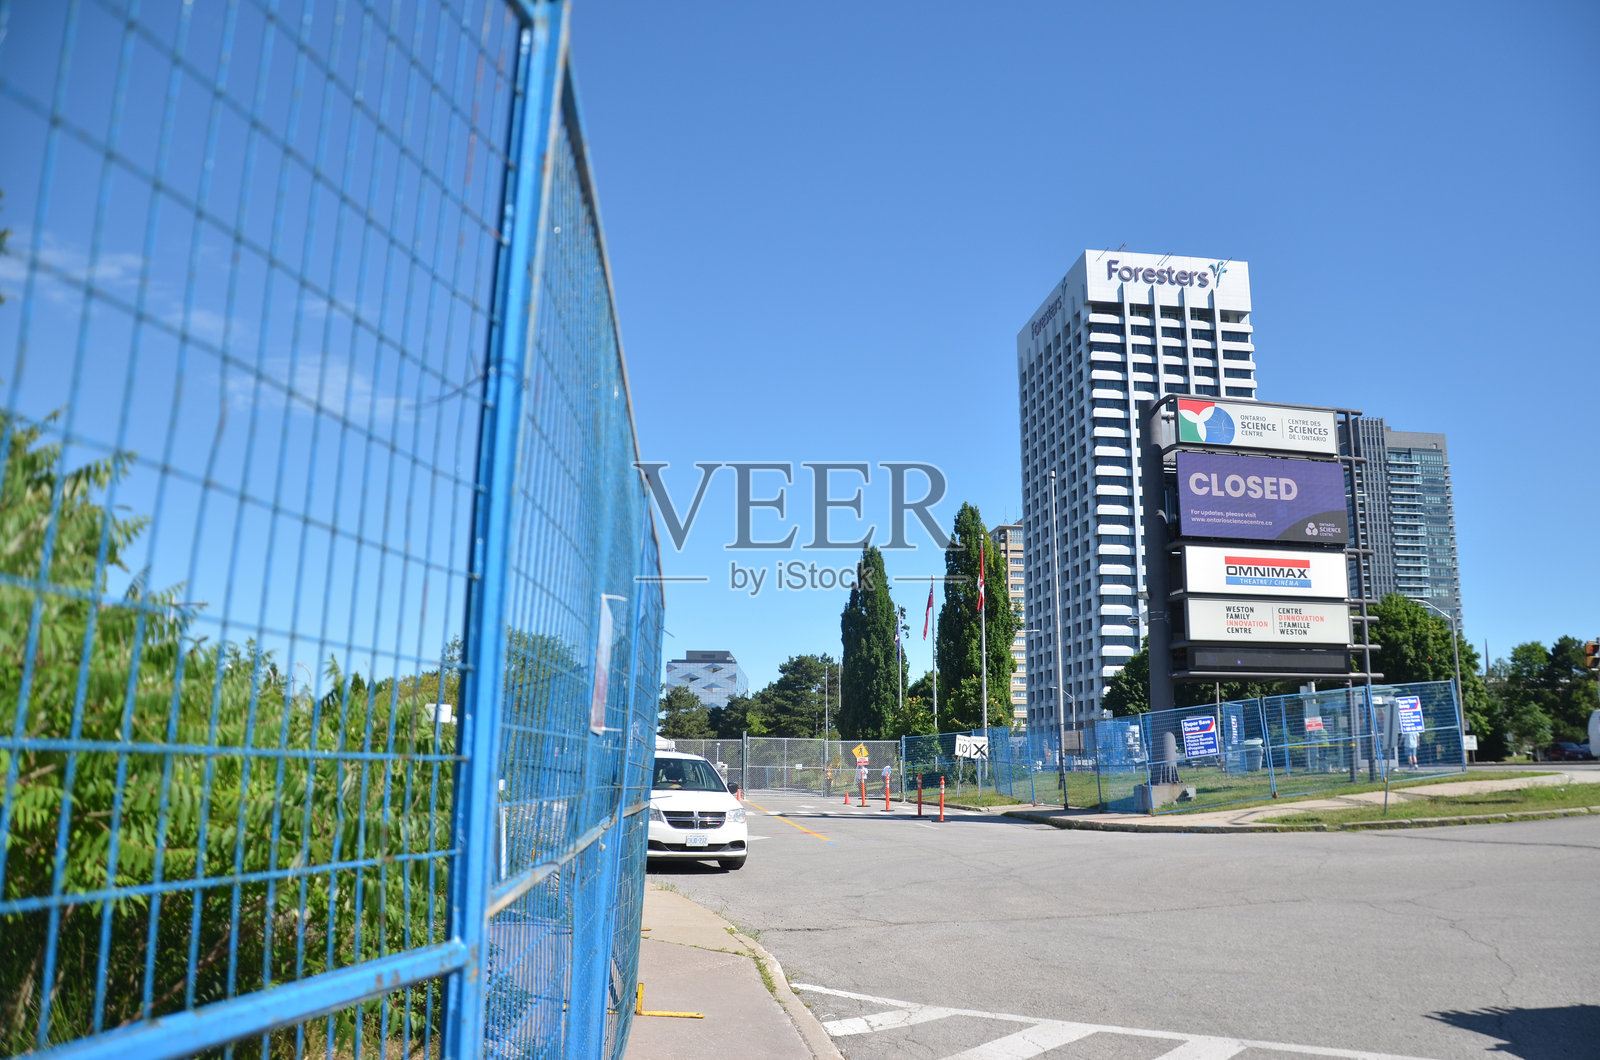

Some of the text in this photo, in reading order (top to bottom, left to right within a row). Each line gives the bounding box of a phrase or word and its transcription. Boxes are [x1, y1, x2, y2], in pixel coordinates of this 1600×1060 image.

[1107, 260, 1210, 287] Foresters
[1032, 295, 1062, 340] Foresters
[1241, 421, 1277, 432] SCIENCE
[1288, 418, 1308, 426] CENTRE
[1288, 425, 1328, 436] SCIENCES
[1189, 472, 1298, 501] CLOSED
[1191, 516, 1273, 526] www.ontariosciencecentre.ca
[1226, 565, 1308, 579] OMNIMAX
[1278, 607, 1302, 615] CENTRE
[1226, 620, 1269, 628] INNOVATION
[1280, 628, 1308, 636] WESTON
